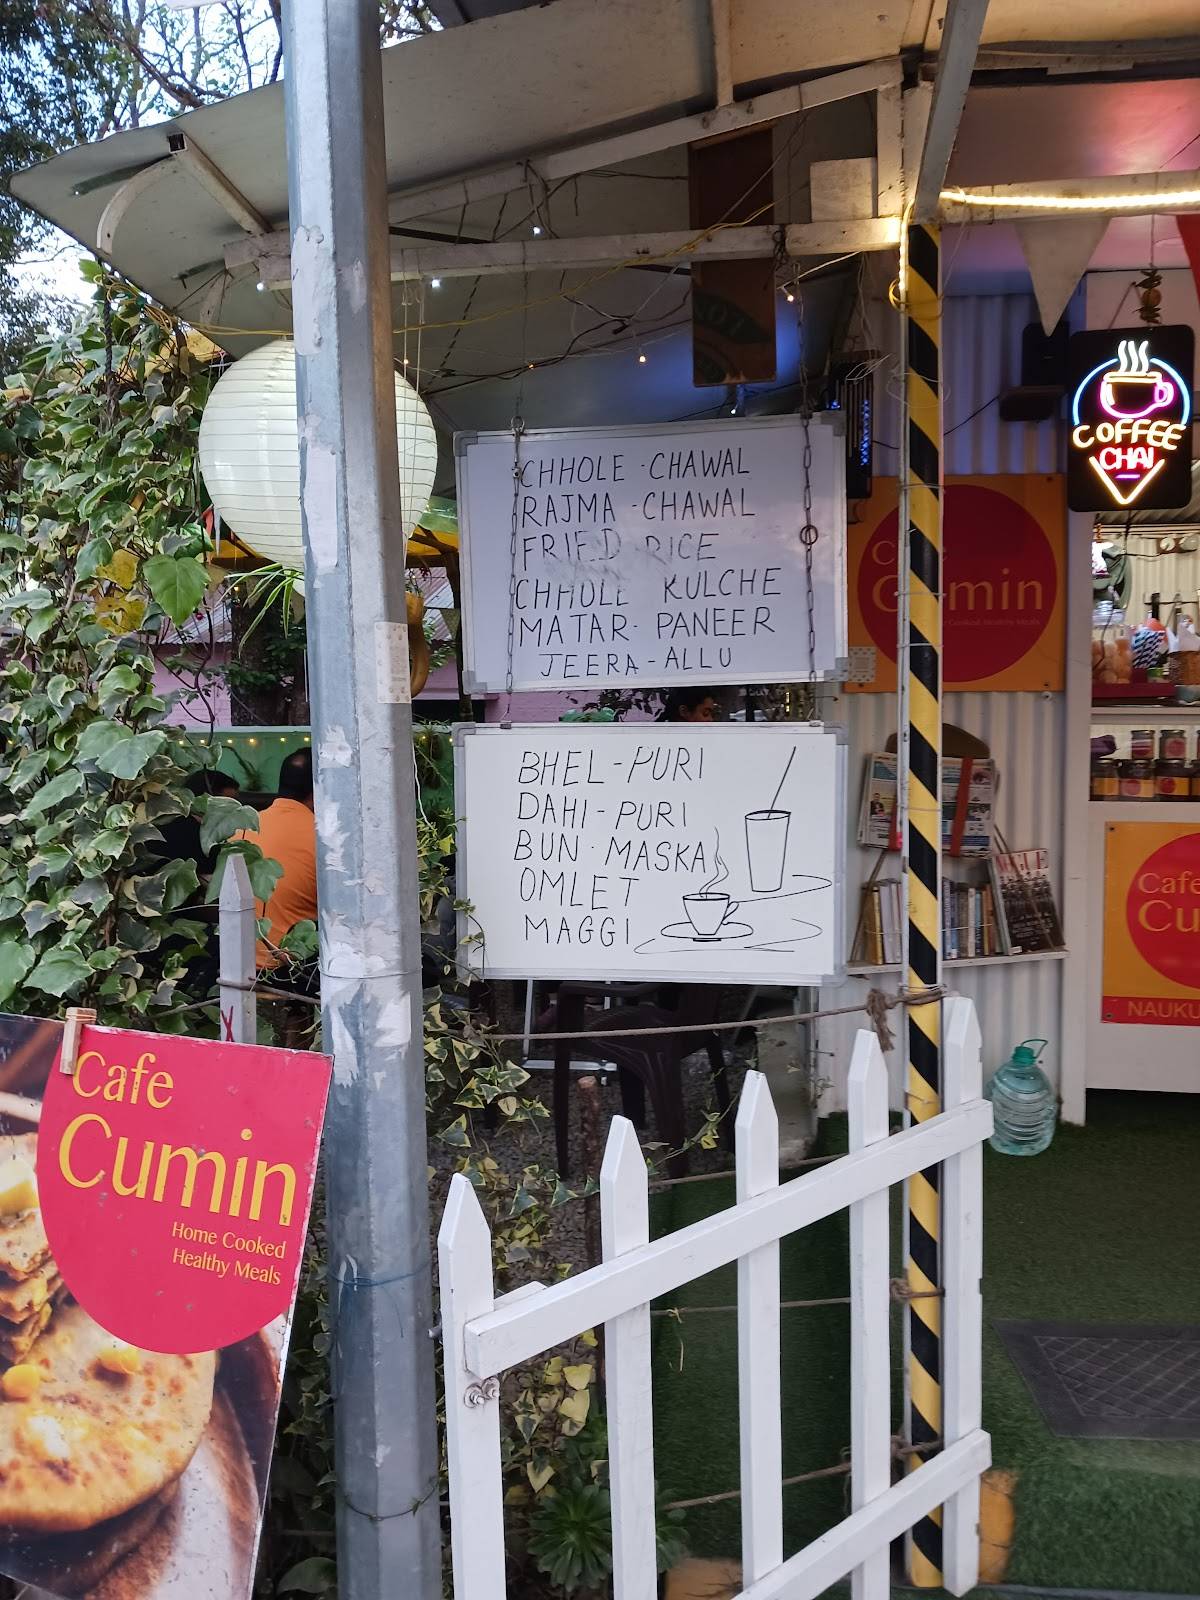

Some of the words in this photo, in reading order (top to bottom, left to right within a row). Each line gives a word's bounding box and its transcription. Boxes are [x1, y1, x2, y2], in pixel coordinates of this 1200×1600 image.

[1072, 418, 1187, 450] COFFEE
[519, 453, 626, 489] CHHOLE
[1099, 446, 1155, 470] CHAI
[521, 493, 617, 529] RAJMA
[663, 566, 783, 604] KULCHE
[656, 605, 776, 641] PANEER
[603, 835, 707, 875] MASKA
[518, 866, 640, 911] OMLET
[524, 914, 630, 948] MAGGI
[72, 1050, 174, 1109] Cafe
[59, 1112, 297, 1227] Cumin
[171, 1220, 217, 1246] Home
[221, 1230, 287, 1260] Cooked
[172, 1247, 230, 1279] Healthy
[234, 1260, 282, 1286] Meals
